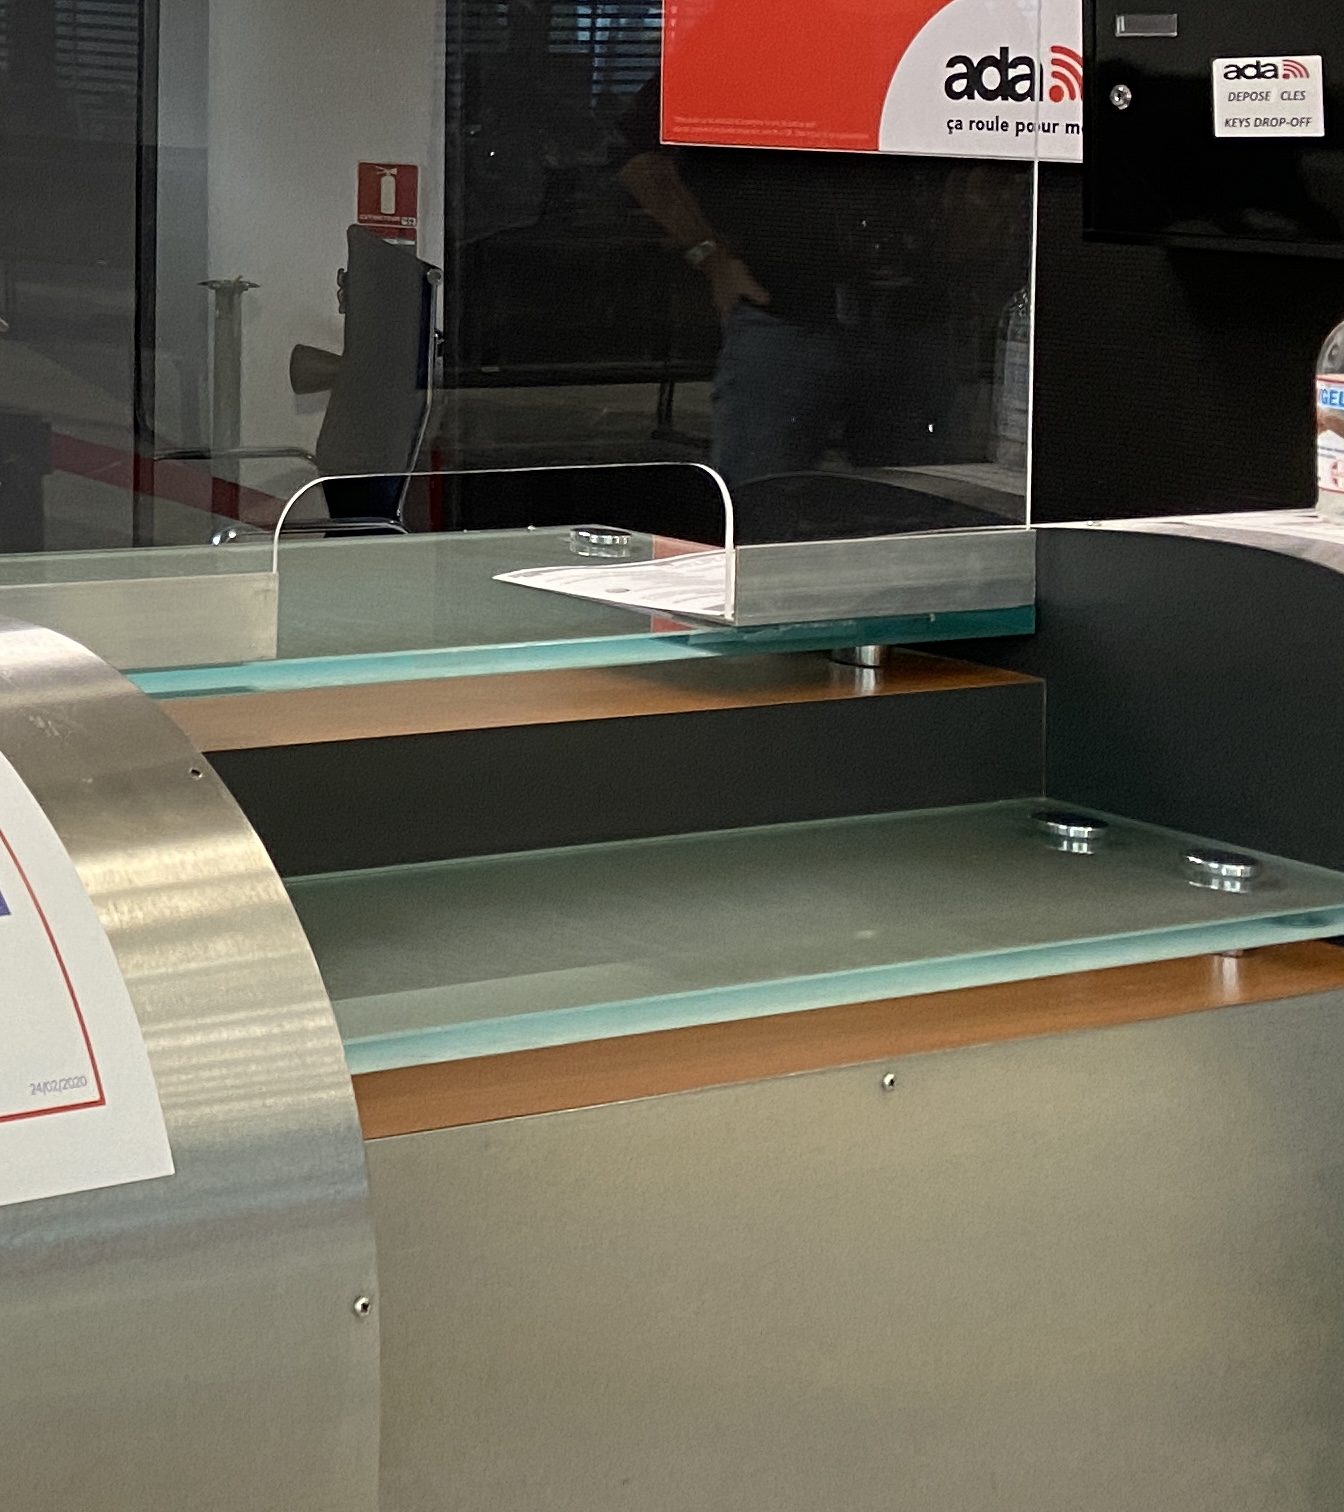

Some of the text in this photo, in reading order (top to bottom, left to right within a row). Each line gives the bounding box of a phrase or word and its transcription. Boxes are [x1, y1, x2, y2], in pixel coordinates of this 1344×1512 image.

[944, 46, 1044, 102] ada
[1223, 60, 1280, 81] ada
[1228, 90, 1307, 102] DEPOSE CLES
[946, 118, 963, 135] ça
[969, 115, 1009, 132] roule
[1224, 117, 1313, 129] KEYS DROP-OFF
